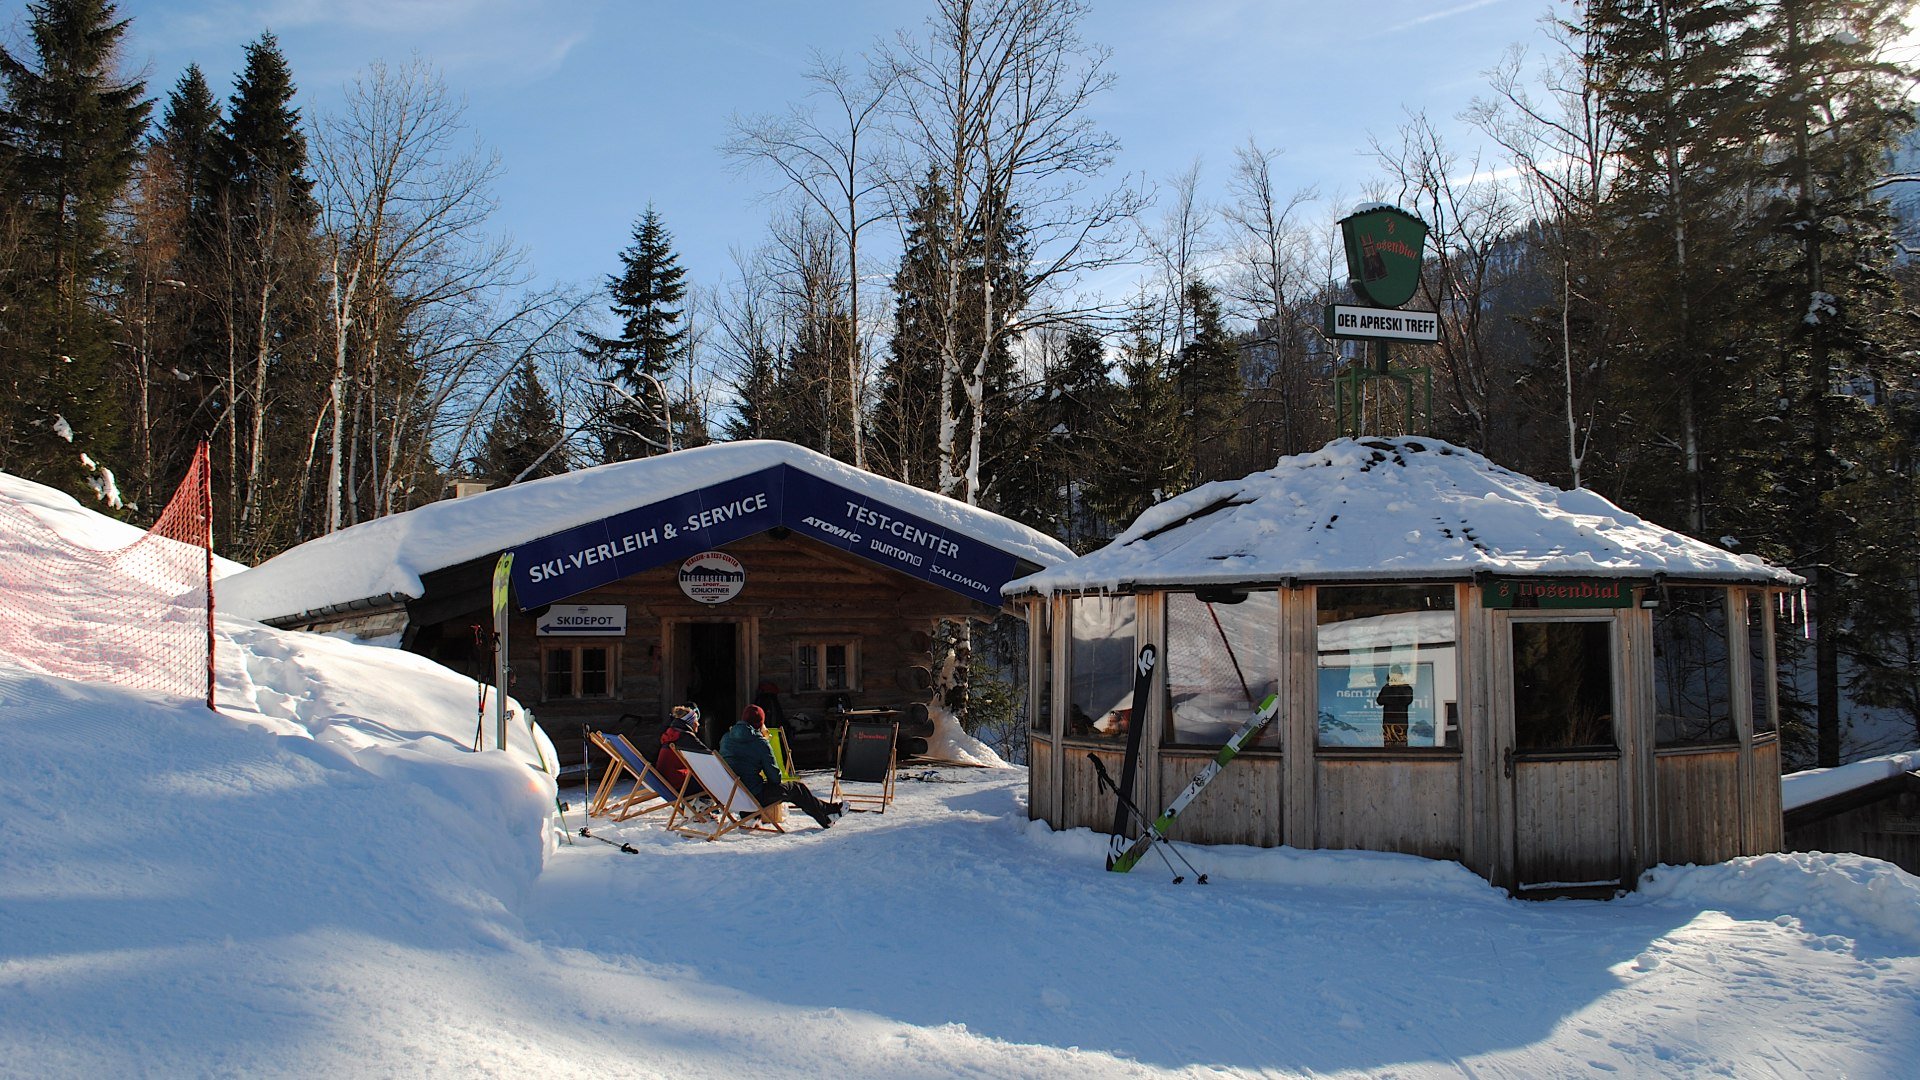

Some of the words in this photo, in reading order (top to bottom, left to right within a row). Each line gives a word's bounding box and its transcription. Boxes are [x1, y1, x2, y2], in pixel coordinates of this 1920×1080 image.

[1338, 313, 1358, 328] DER
[1360, 315, 1403, 332] APRESKI
[1405, 318, 1435, 334] TREFF
[529, 528, 659, 584] SKI-VERLEIH
[663, 523, 678, 541] &
[682, 492, 768, 533] -SERVICE
[846, 501, 960, 559] TEST-CENTER
[801, 516, 862, 543] ATOMIC
[870, 539, 914, 564] BURTON
[929, 564, 991, 593] SALOMON
[683, 575, 727, 583] TEGERNSEER
[730, 575, 741, 583] TAL
[556, 616, 614, 625] SKIDEPOT
